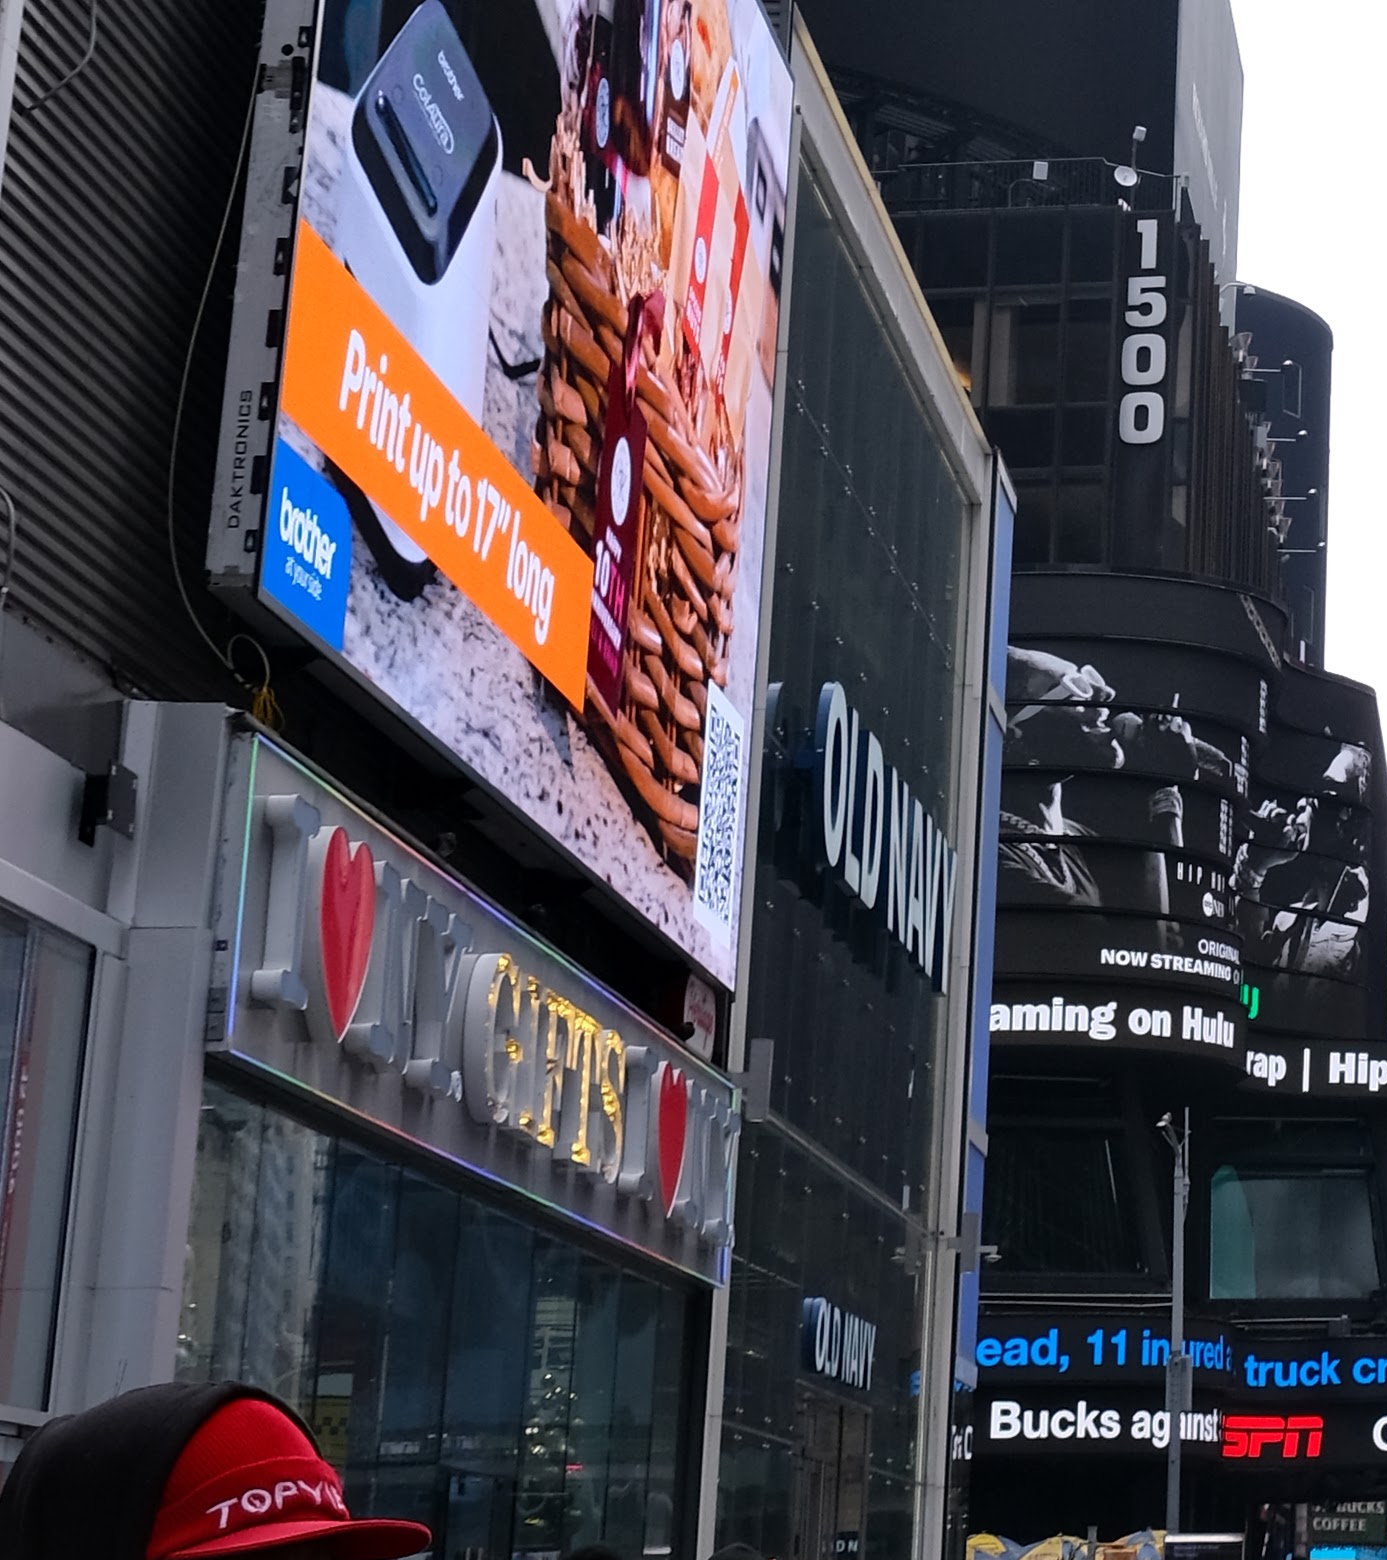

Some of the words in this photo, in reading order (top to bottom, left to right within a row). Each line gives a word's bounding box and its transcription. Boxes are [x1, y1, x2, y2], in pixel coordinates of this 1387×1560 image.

[1119, 219, 1167, 444] 1500
[227, 390, 252, 530] DAKTRONICS
[339, 329, 411, 473] Print
[409, 423, 444, 522] up
[444, 449, 471, 538] to
[506, 510, 555, 645] long
[279, 486, 337, 579] brother
[818, 681, 884, 910] OLD
[887, 766, 957, 997] NAVY
[1100, 948, 1147, 968] NOW
[1150, 954, 1231, 982] STREAMING
[989, 997, 1117, 1040] aming
[1128, 1006, 1171, 1037] on
[1182, 1006, 1235, 1048] Hulu
[812, 1297, 841, 1377] OLD
[841, 1311, 876, 1391] NAVY
[976, 1328, 1070, 1373] ead,
[1087, 1329, 1127, 1366] 11
[1142, 1329, 1223, 1370] inured
[1244, 1351, 1341, 1388] truck
[990, 1400, 1120, 1441] Bucks
[1312, 1517, 1366, 1531] COFFEE
